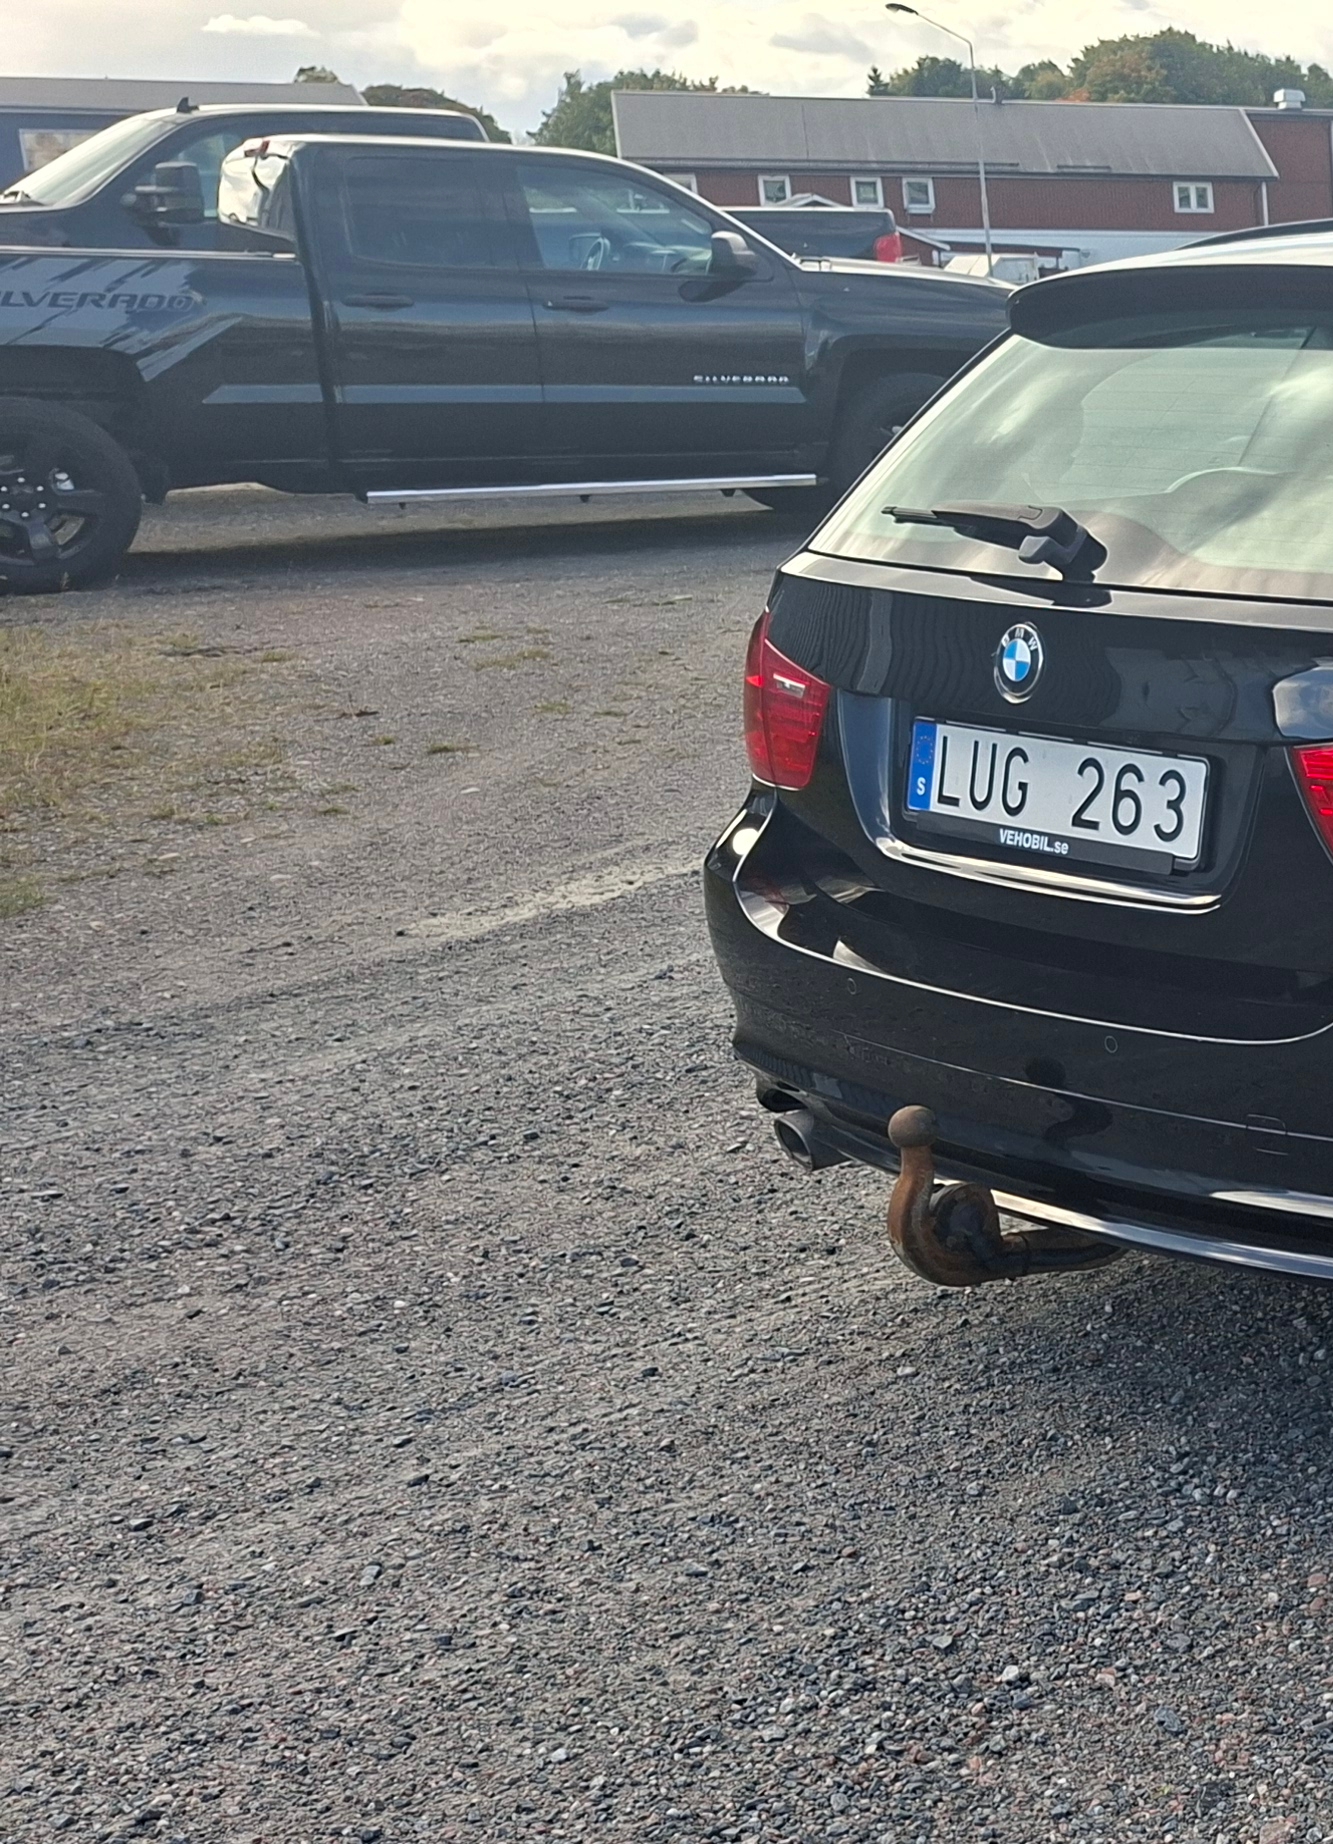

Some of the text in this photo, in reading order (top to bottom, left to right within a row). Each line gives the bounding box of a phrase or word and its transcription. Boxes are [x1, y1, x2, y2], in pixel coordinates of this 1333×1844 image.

[0, 291, 196, 312] LVERADO
[1001, 627, 1038, 651] BMW
[916, 777, 926, 796] S
[937, 735, 1187, 842] LUG 263
[999, 828, 1069, 855] VEHOBIL.se
